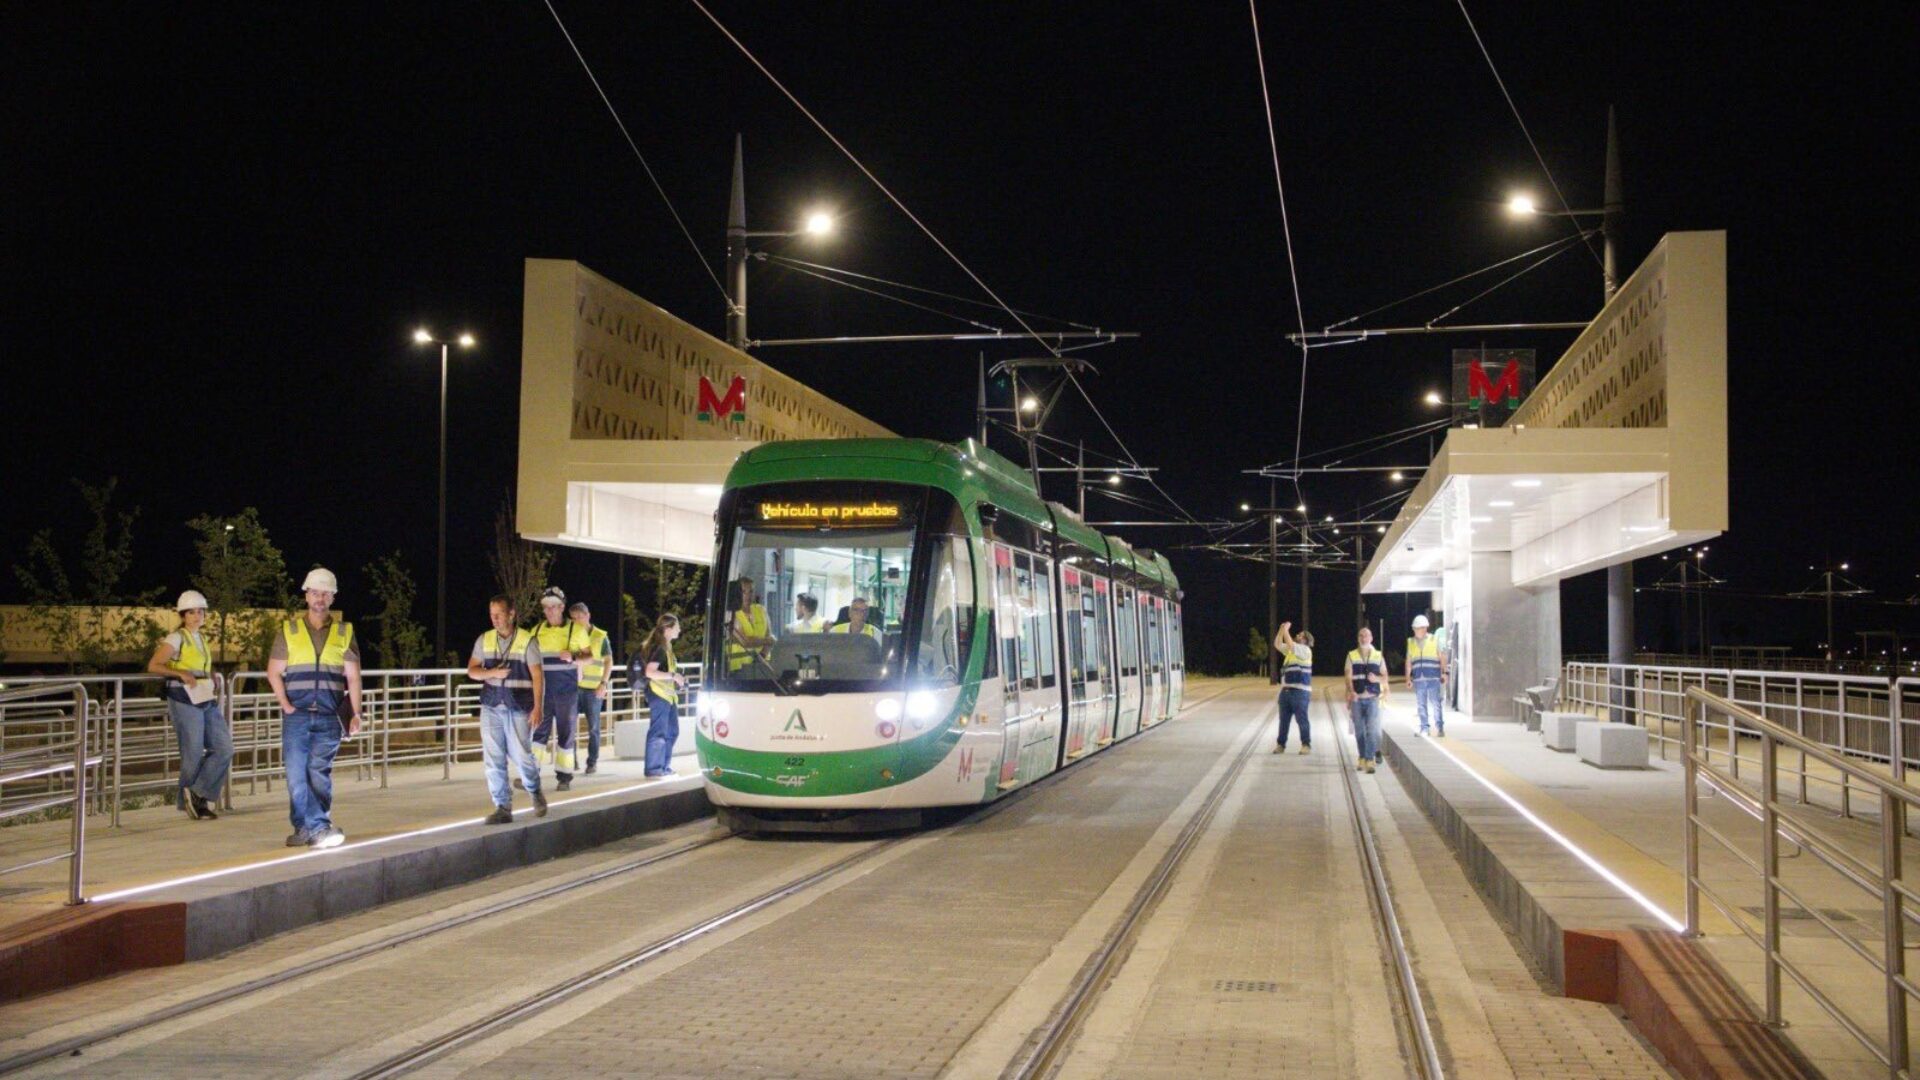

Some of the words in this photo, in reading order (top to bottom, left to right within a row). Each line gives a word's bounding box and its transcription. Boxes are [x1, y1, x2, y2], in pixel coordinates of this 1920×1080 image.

[1469, 358, 1519, 409] M
[698, 375, 745, 421] M
[761, 503, 818, 518] Vehículo
[822, 509, 838, 517] en
[841, 503, 898, 518] pruebas
[784, 757, 805, 767] 422
[776, 774, 806, 787] CAF
